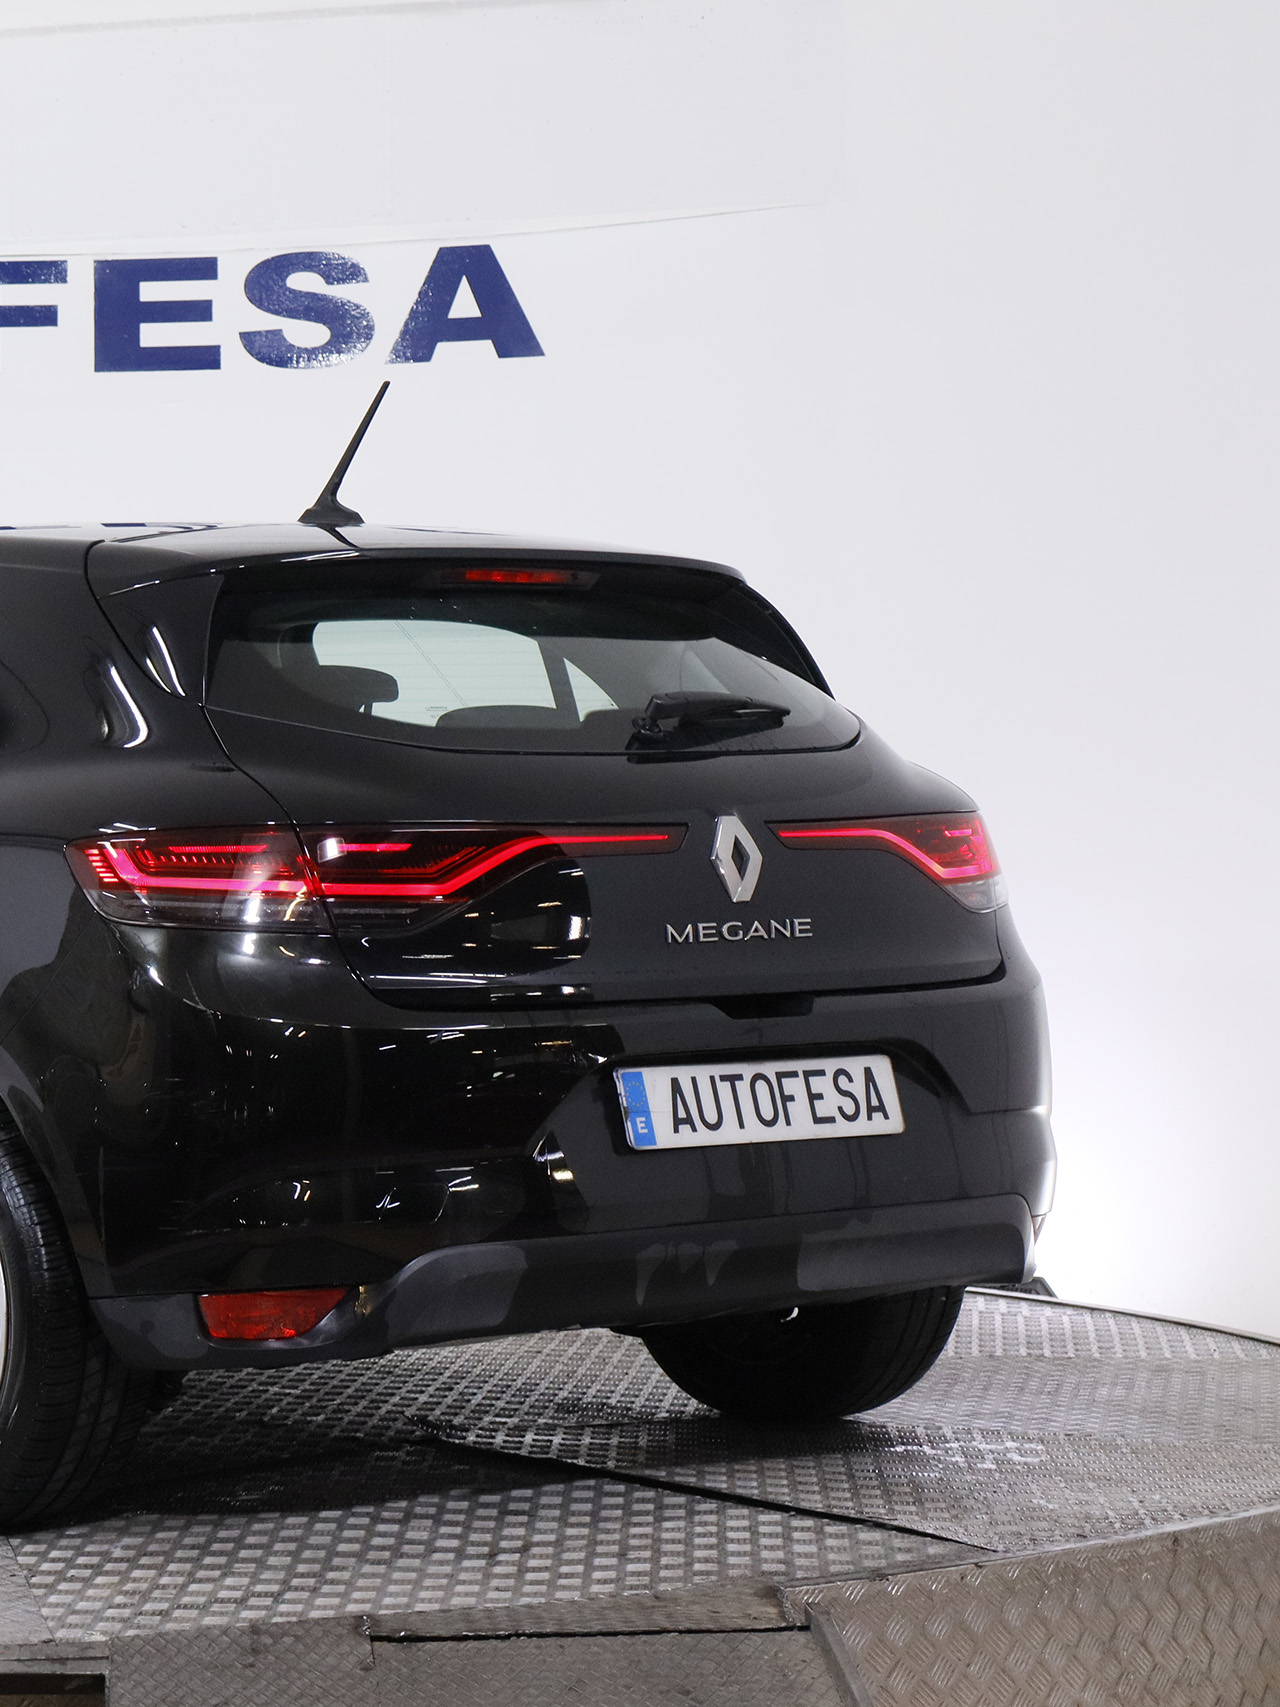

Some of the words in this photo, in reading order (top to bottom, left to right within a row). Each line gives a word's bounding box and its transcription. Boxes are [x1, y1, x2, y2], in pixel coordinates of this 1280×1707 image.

[665, 918, 813, 943] MEGANE
[670, 1066, 890, 1134] AUTOFESA
[636, 1116, 649, 1134] E
